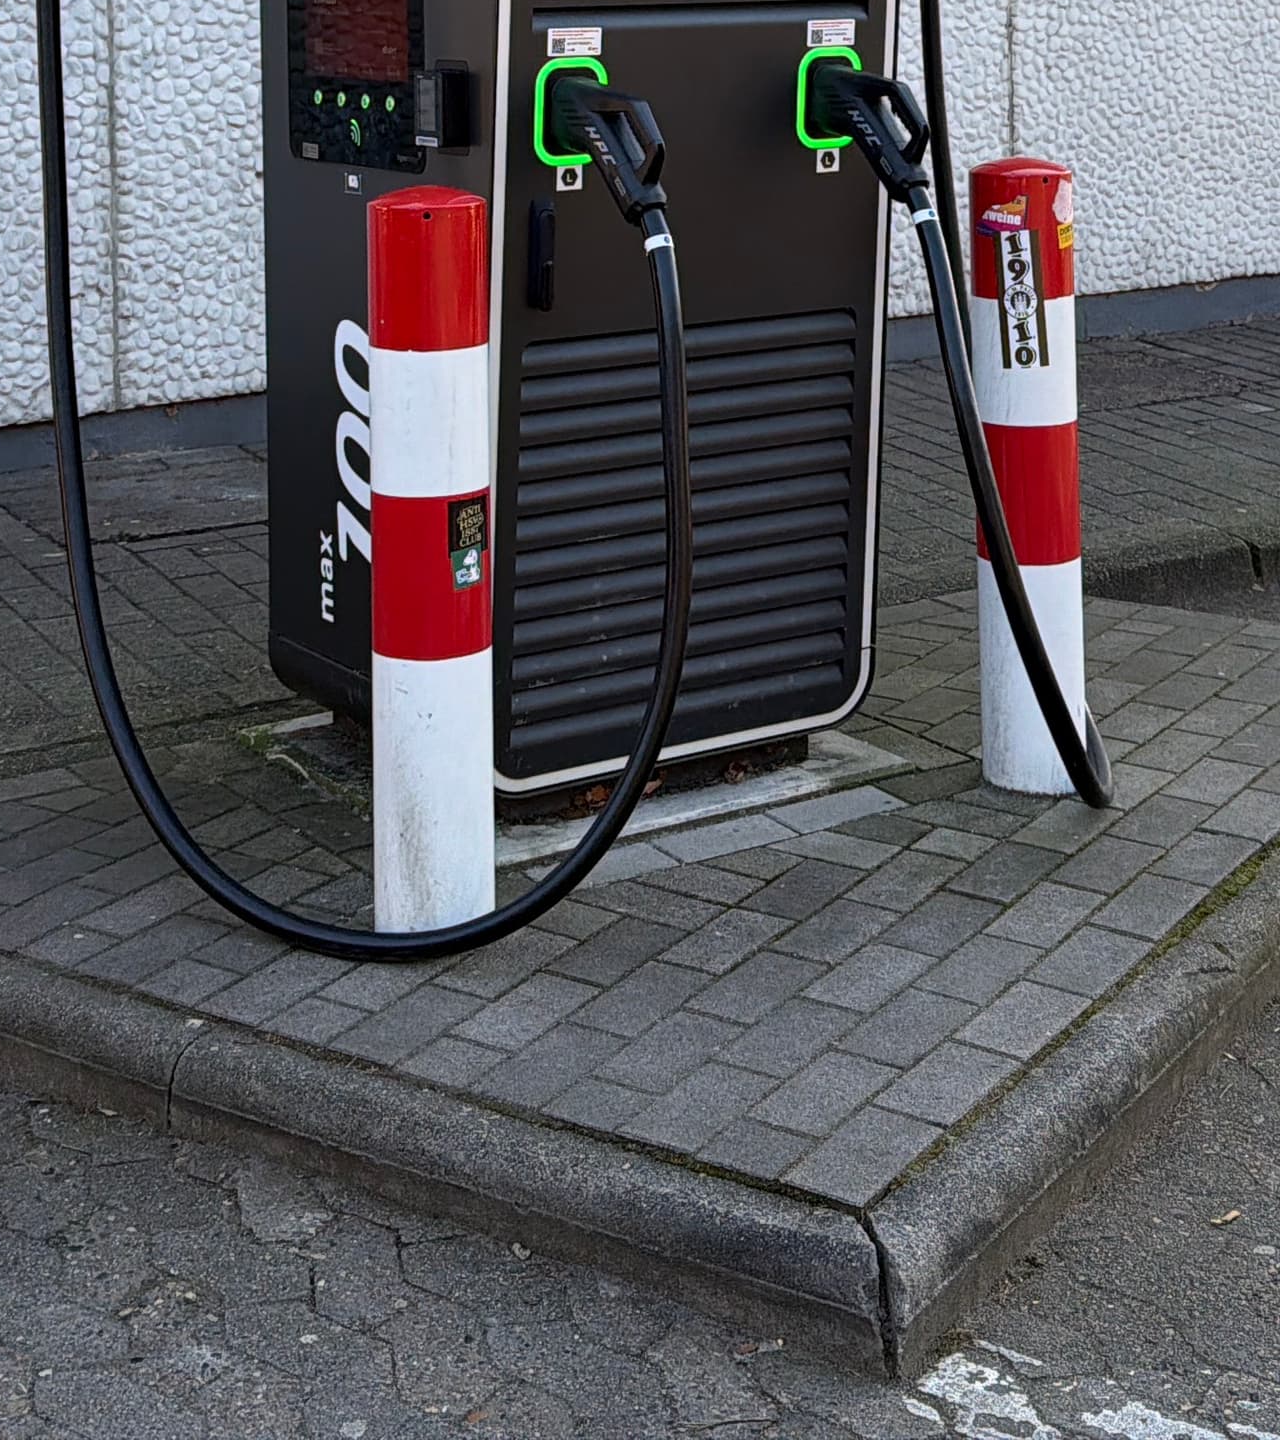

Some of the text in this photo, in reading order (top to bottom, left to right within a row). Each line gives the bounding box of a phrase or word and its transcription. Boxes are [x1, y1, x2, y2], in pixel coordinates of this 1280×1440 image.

[583, 126, 617, 166] HPC
[847, 110, 882, 147] HPC
[320, 530, 335, 623] max
